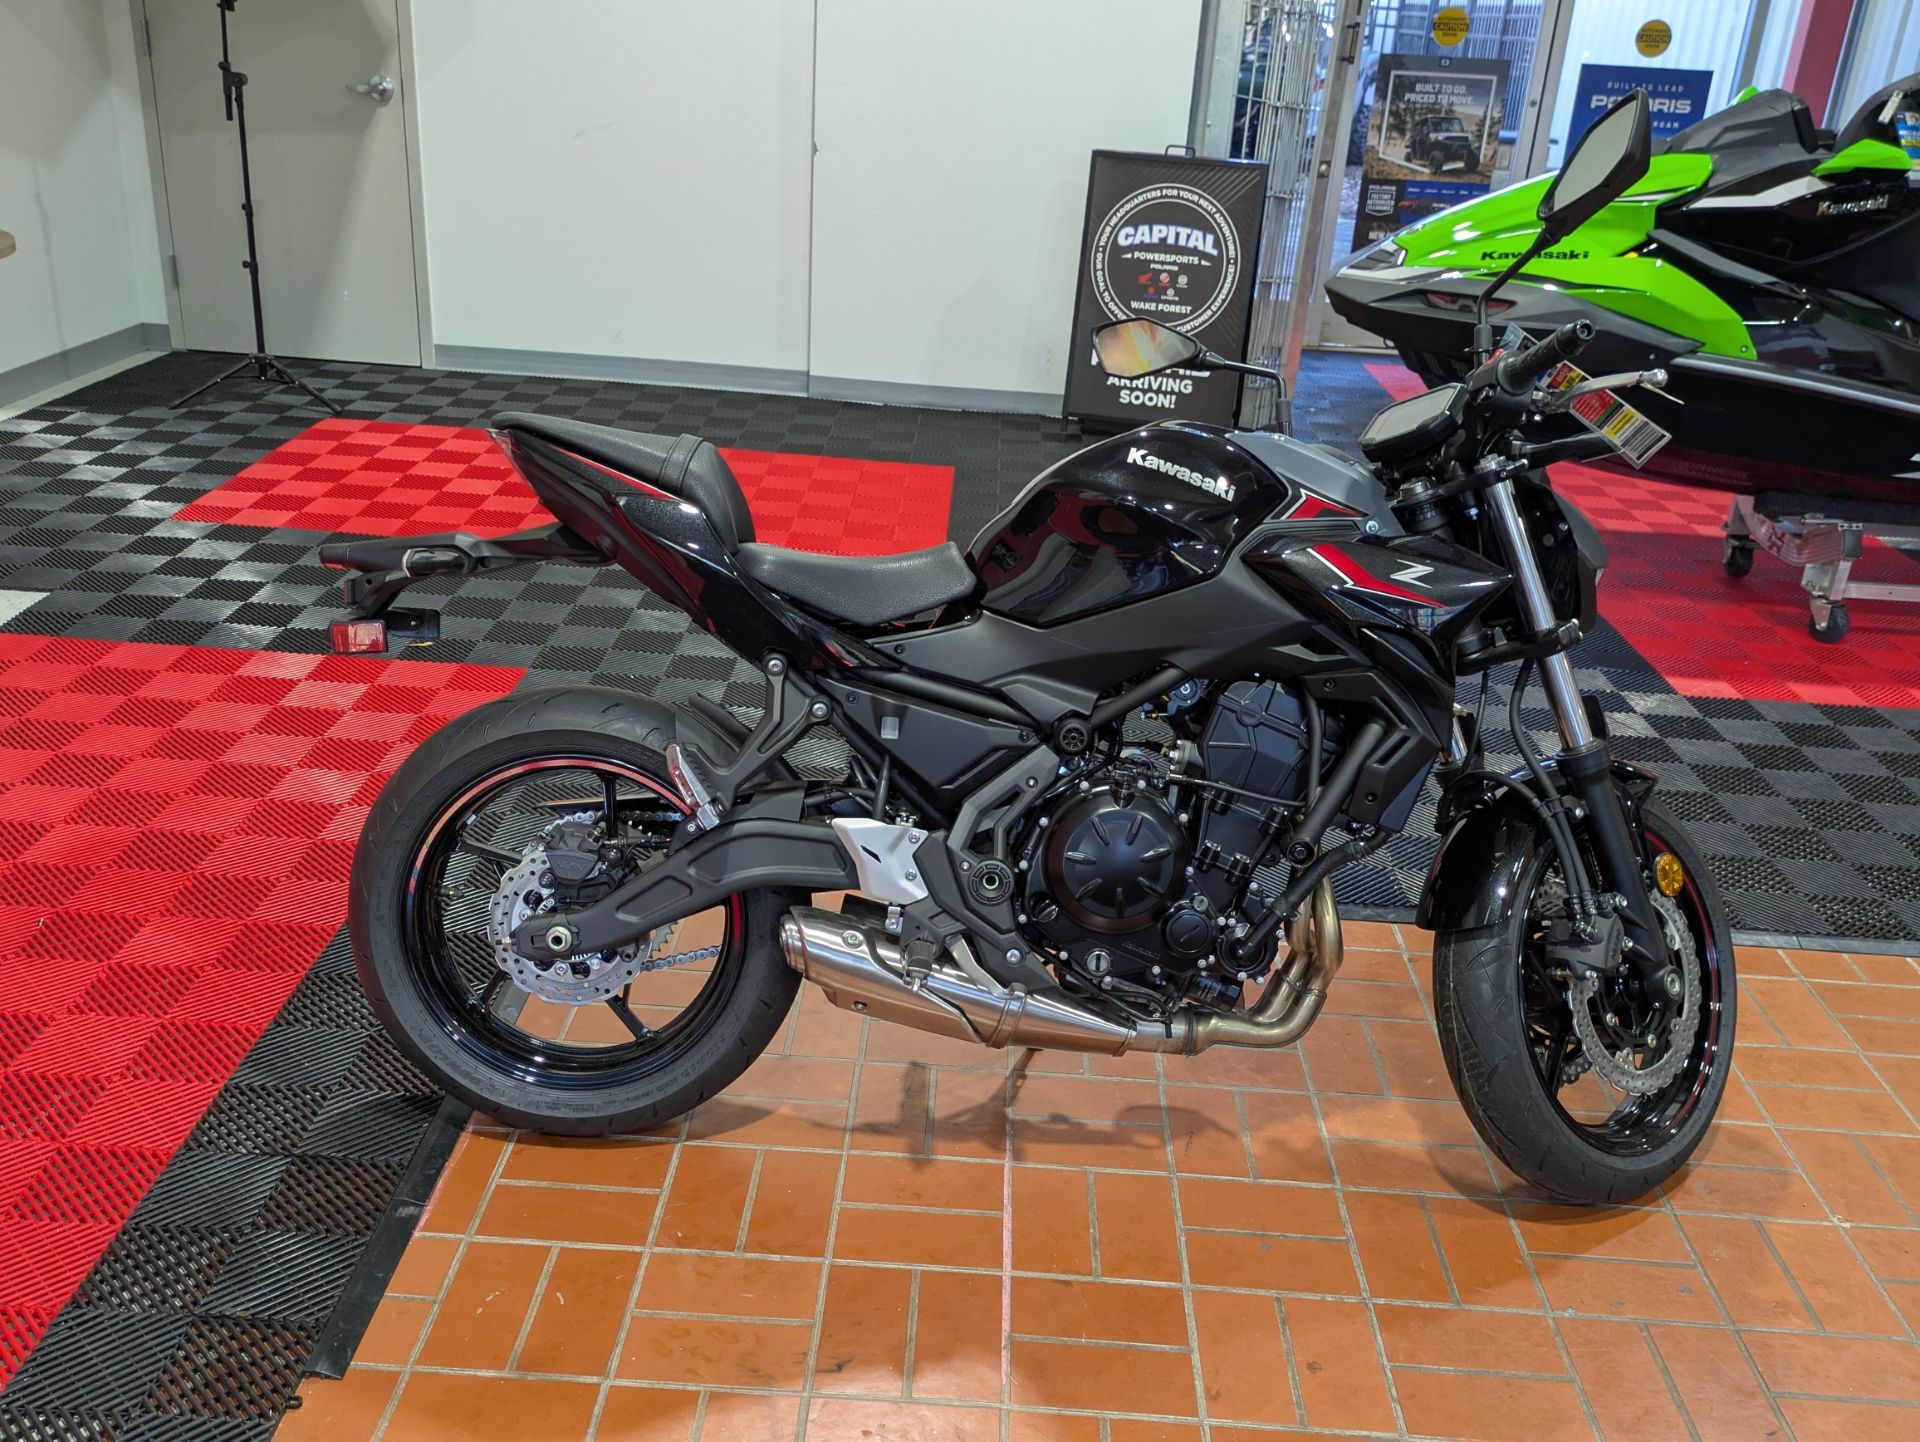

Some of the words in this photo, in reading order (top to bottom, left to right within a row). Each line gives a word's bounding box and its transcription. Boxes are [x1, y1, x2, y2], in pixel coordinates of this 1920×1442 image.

[1415, 83, 1440, 93] BUILT
[1442, 85, 1453, 93] TO
[1607, 82, 1636, 90] BUILT
[1658, 85, 1684, 93] LEAD
[1405, 92, 1436, 103] PRICED
[1437, 94, 1448, 104] TO
[1817, 194, 1889, 216] Kawasaki
[1099, 226, 1112, 247] YOUR
[1110, 189, 1161, 227] HEADQUARTERS
[1162, 188, 1178, 197] FOR
[1179, 190, 1200, 203] YOUR
[1198, 198, 1217, 216] NEXT
[1214, 211, 1236, 259] ADVENTURE!
[1117, 224, 1218, 256] CAPITAL
[1134, 251, 1199, 265] POWERSPORTS
[1096, 268, 1105, 293] GOAL
[1102, 291, 1110, 303] TO
[1211, 265, 1236, 312] EXPERIENCE!
[1130, 301, 1156, 311] WAKE
[1158, 303, 1193, 314] FOREST
[1119, 390, 1176, 409] SOON!
[1126, 447, 1236, 502] Kawasaki
